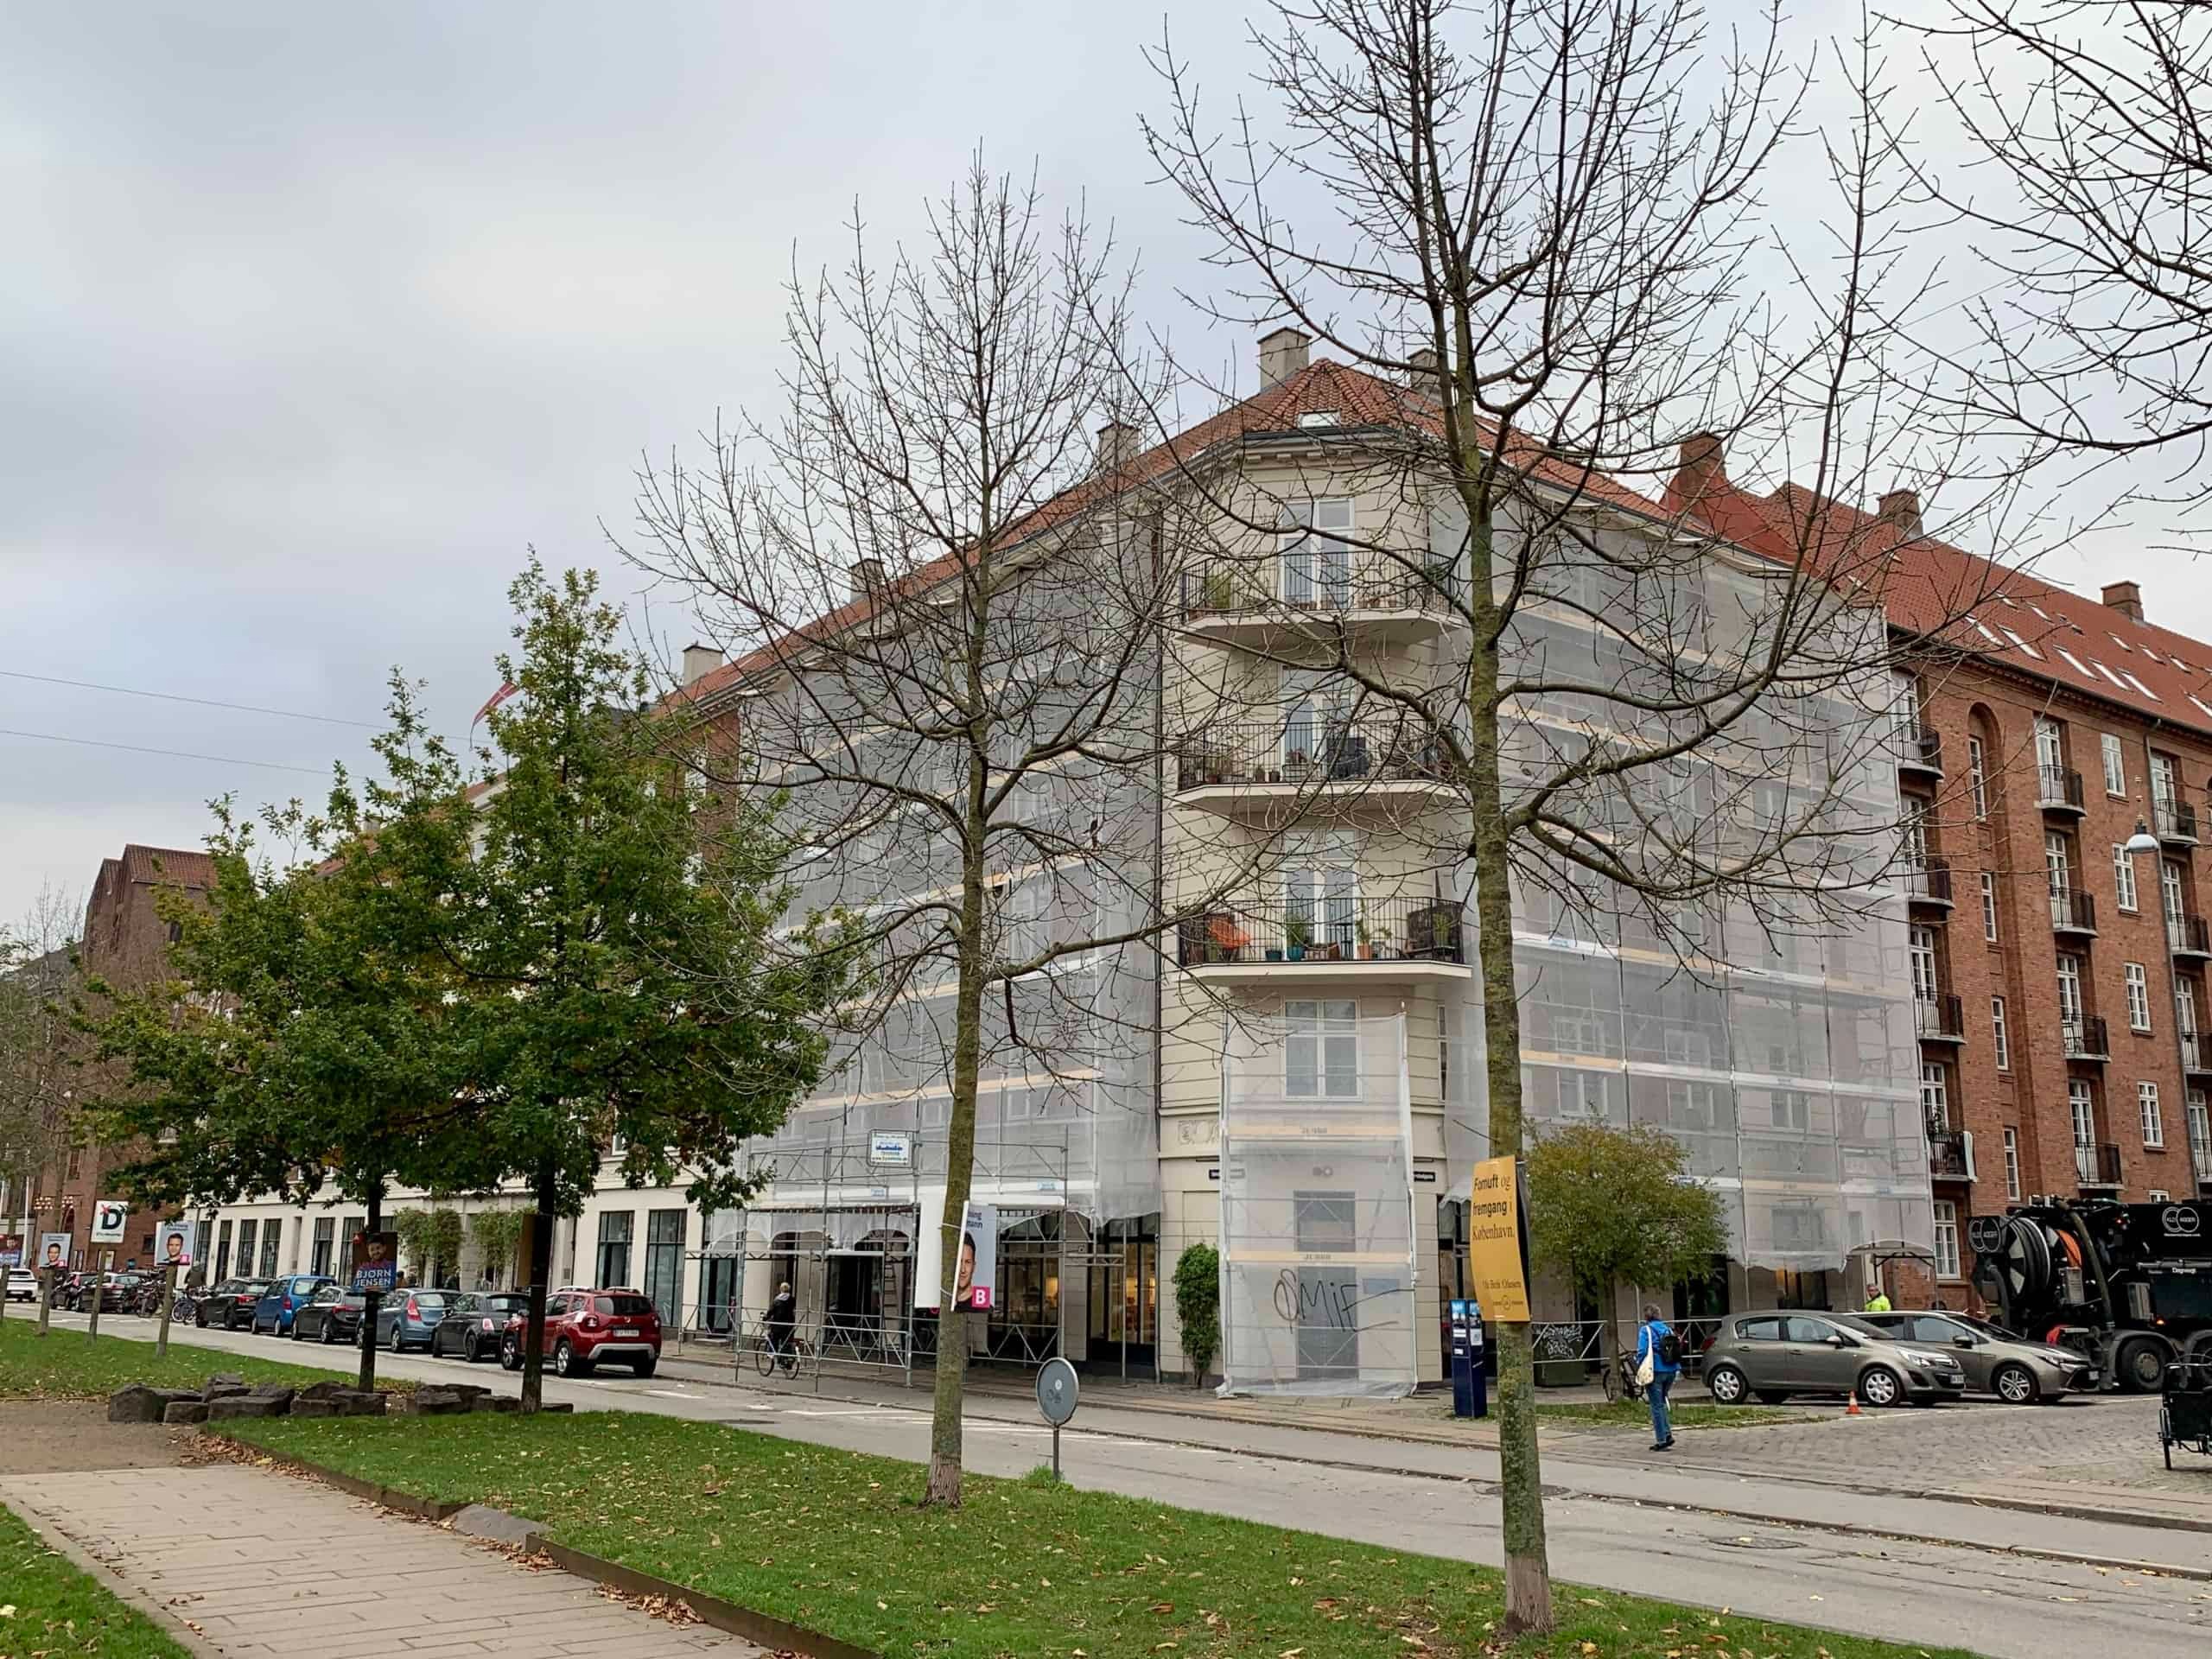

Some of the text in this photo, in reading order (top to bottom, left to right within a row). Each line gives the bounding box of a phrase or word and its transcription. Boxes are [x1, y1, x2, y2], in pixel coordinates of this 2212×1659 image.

[1500, 1176, 1512, 1191] og
[1473, 1200, 1508, 1217] fremgang
[102, 1209, 123, 1230] D
[354, 1278, 391, 1287] JENSEN
[975, 1288, 986, 1305] B
